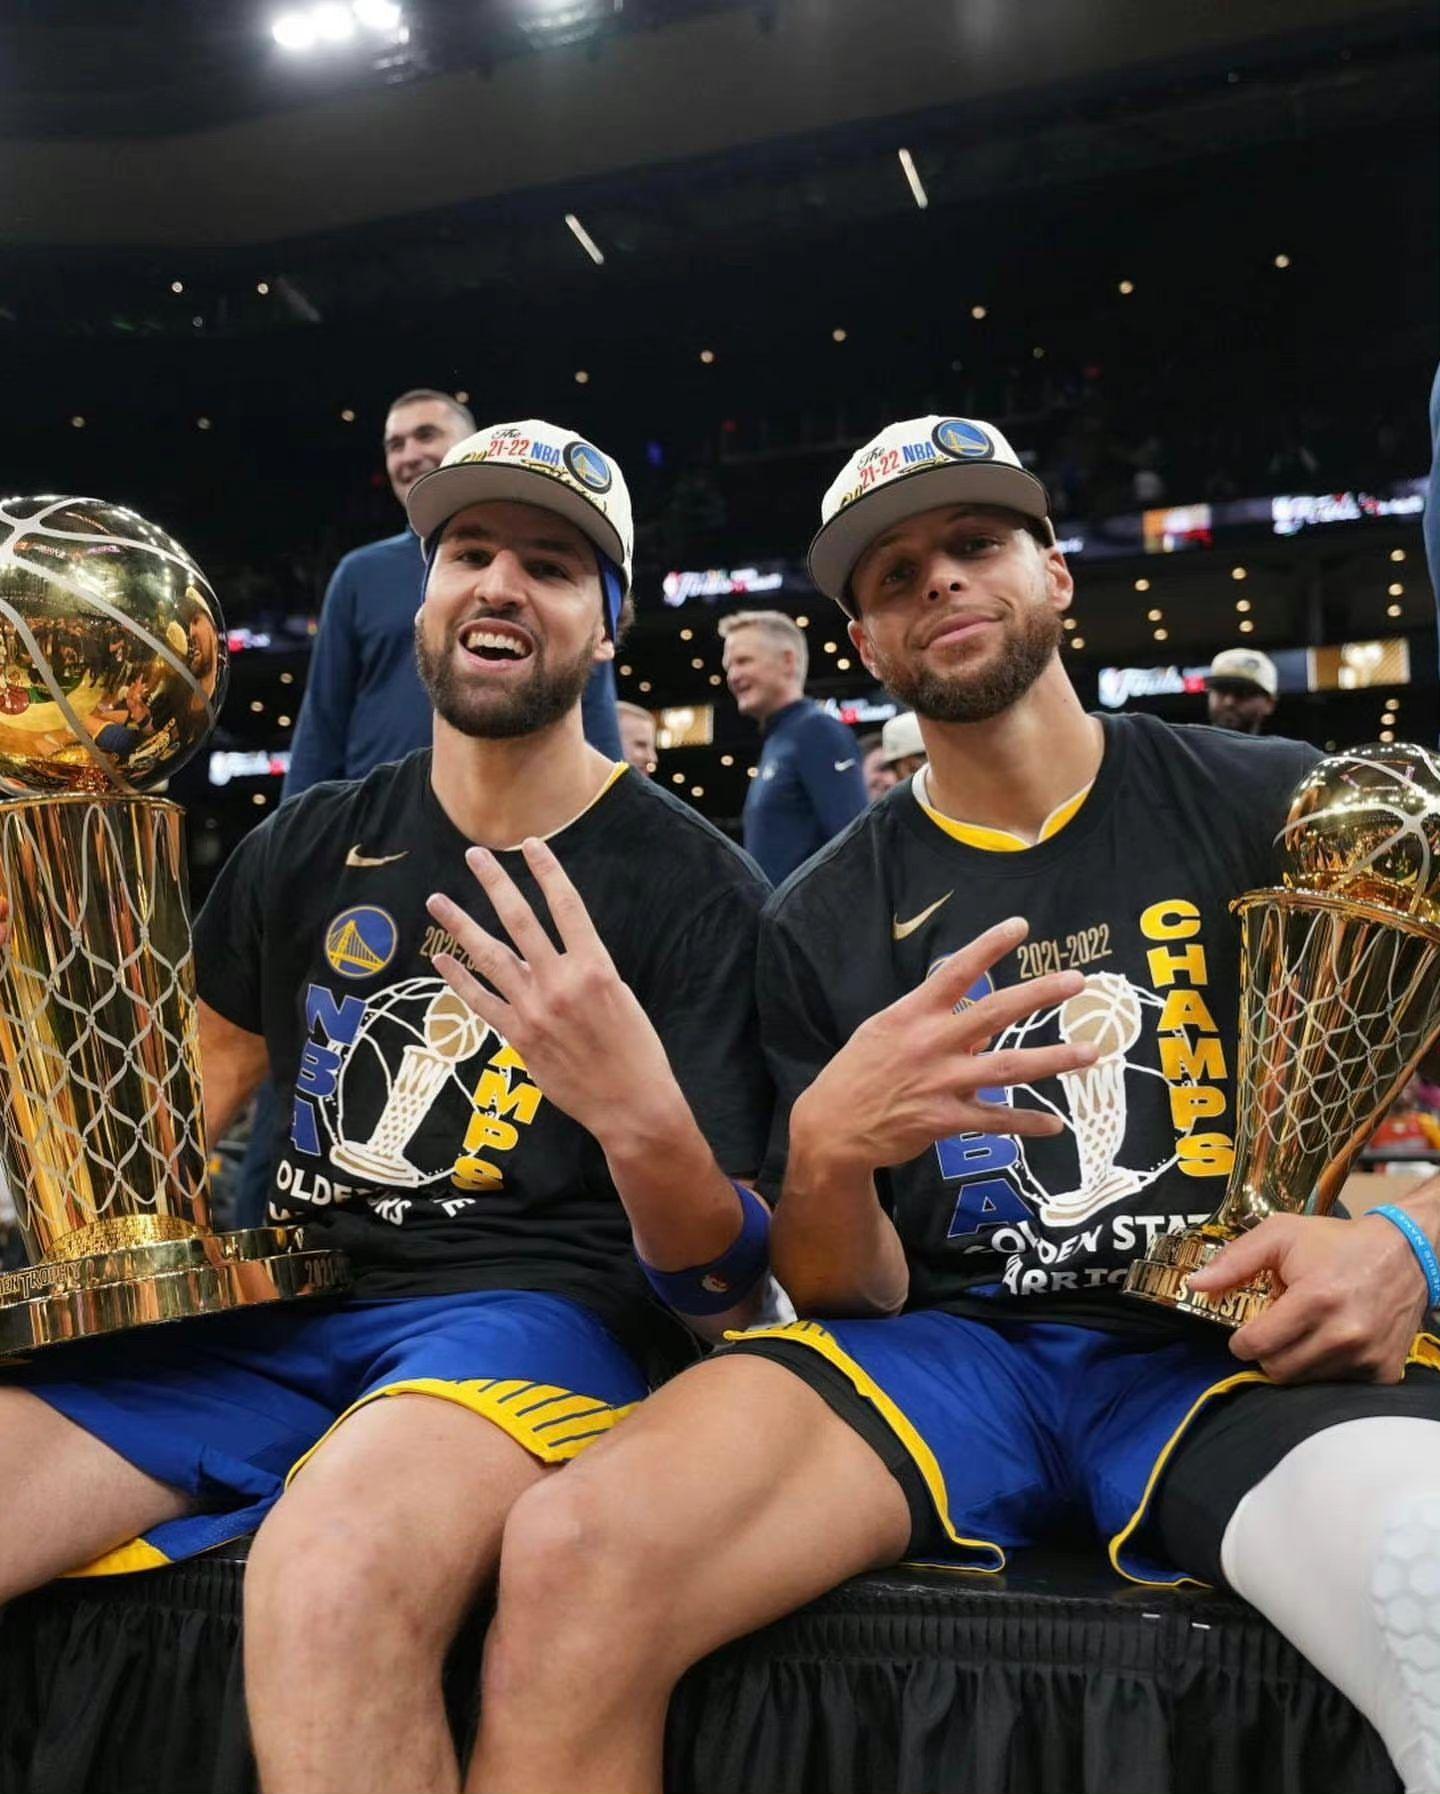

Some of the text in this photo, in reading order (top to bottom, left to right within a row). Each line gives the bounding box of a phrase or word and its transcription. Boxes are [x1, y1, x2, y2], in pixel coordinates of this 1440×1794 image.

[488, 439, 530, 457] 21-22
[530, 442, 560, 465] NBA
[860, 450, 900, 489] 21-22
[902, 441, 936, 464] NBA
[1017, 923, 1113, 978] 2021-2022
[1140, 899, 1235, 1177] CHAMPS
[451, 1042, 542, 1191] AMPS
[276, 1159, 352, 1206] OLDE
[991, 1220, 1103, 1265] OLDEN
[20, 1261, 81, 1299] TROPHY
